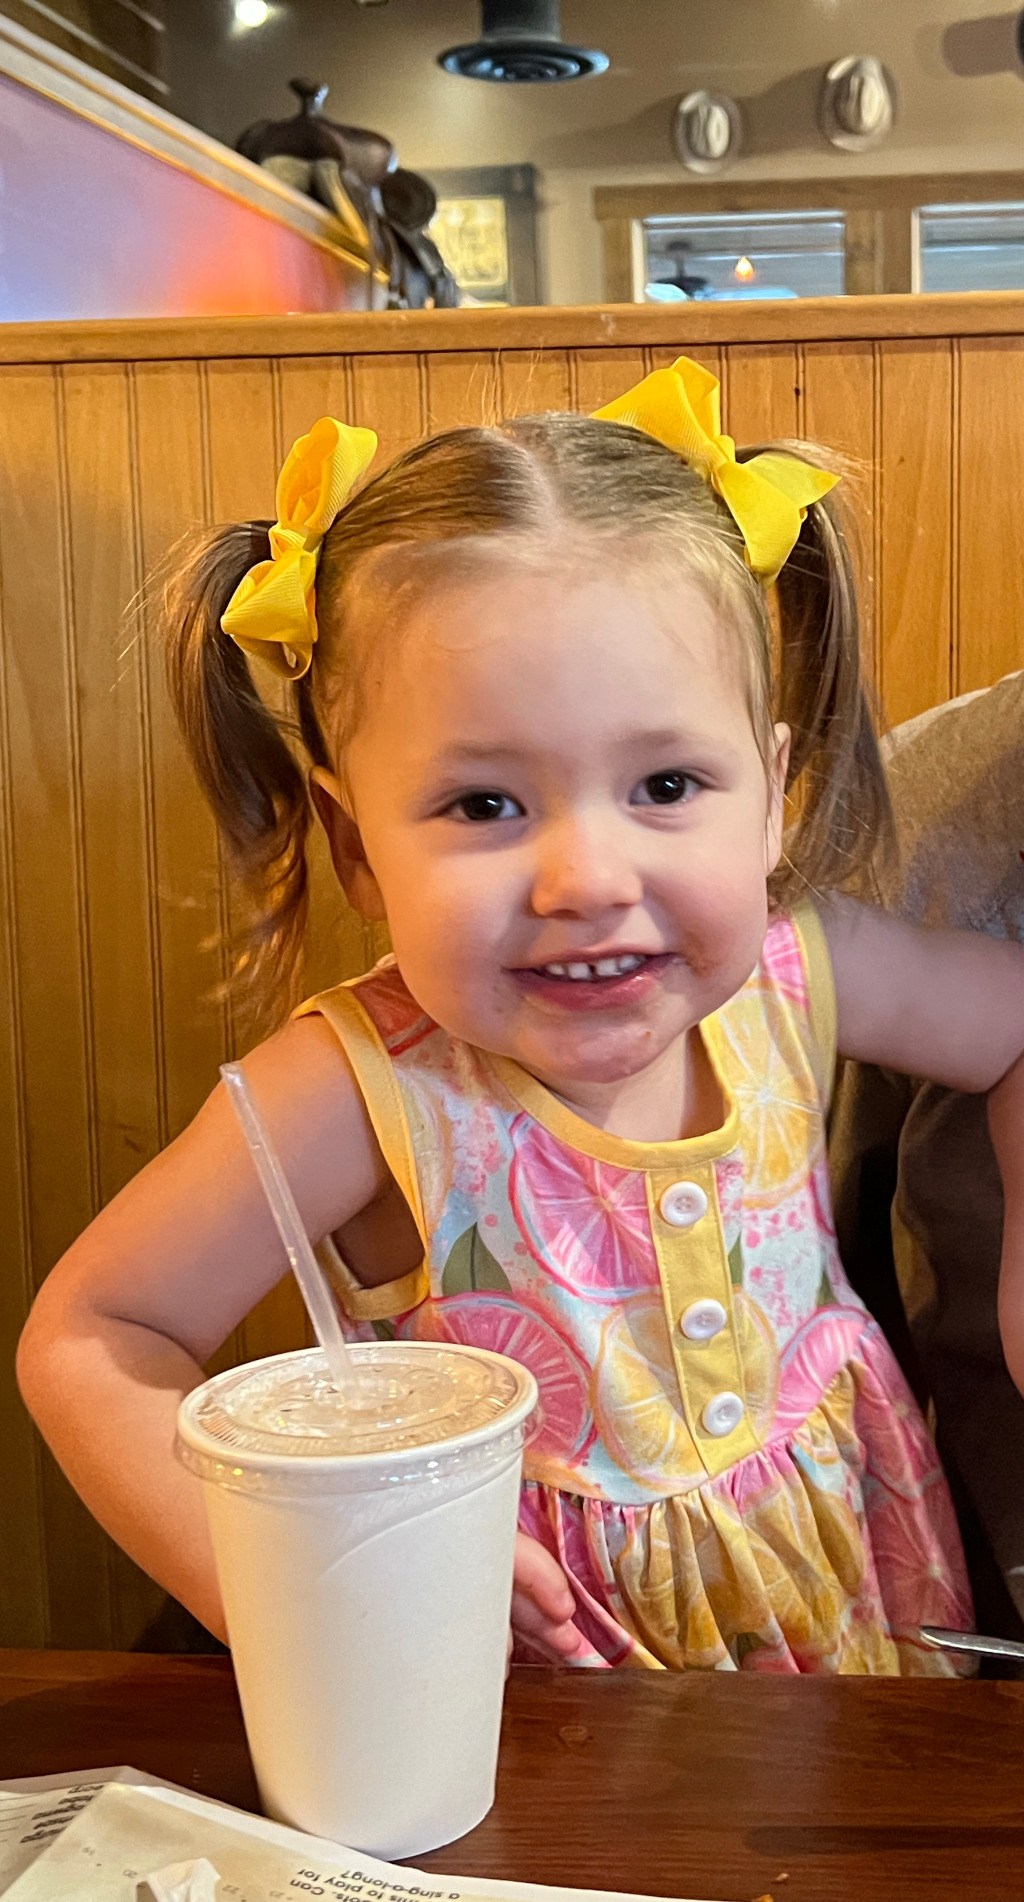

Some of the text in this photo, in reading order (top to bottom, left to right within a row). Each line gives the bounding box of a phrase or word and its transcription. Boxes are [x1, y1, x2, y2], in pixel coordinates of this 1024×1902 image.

[297, 1869, 321, 1881] for
[290, 1879, 324, 1895] Can
[324, 1877, 363, 1892] play
[367, 1890, 384, 1899] to
